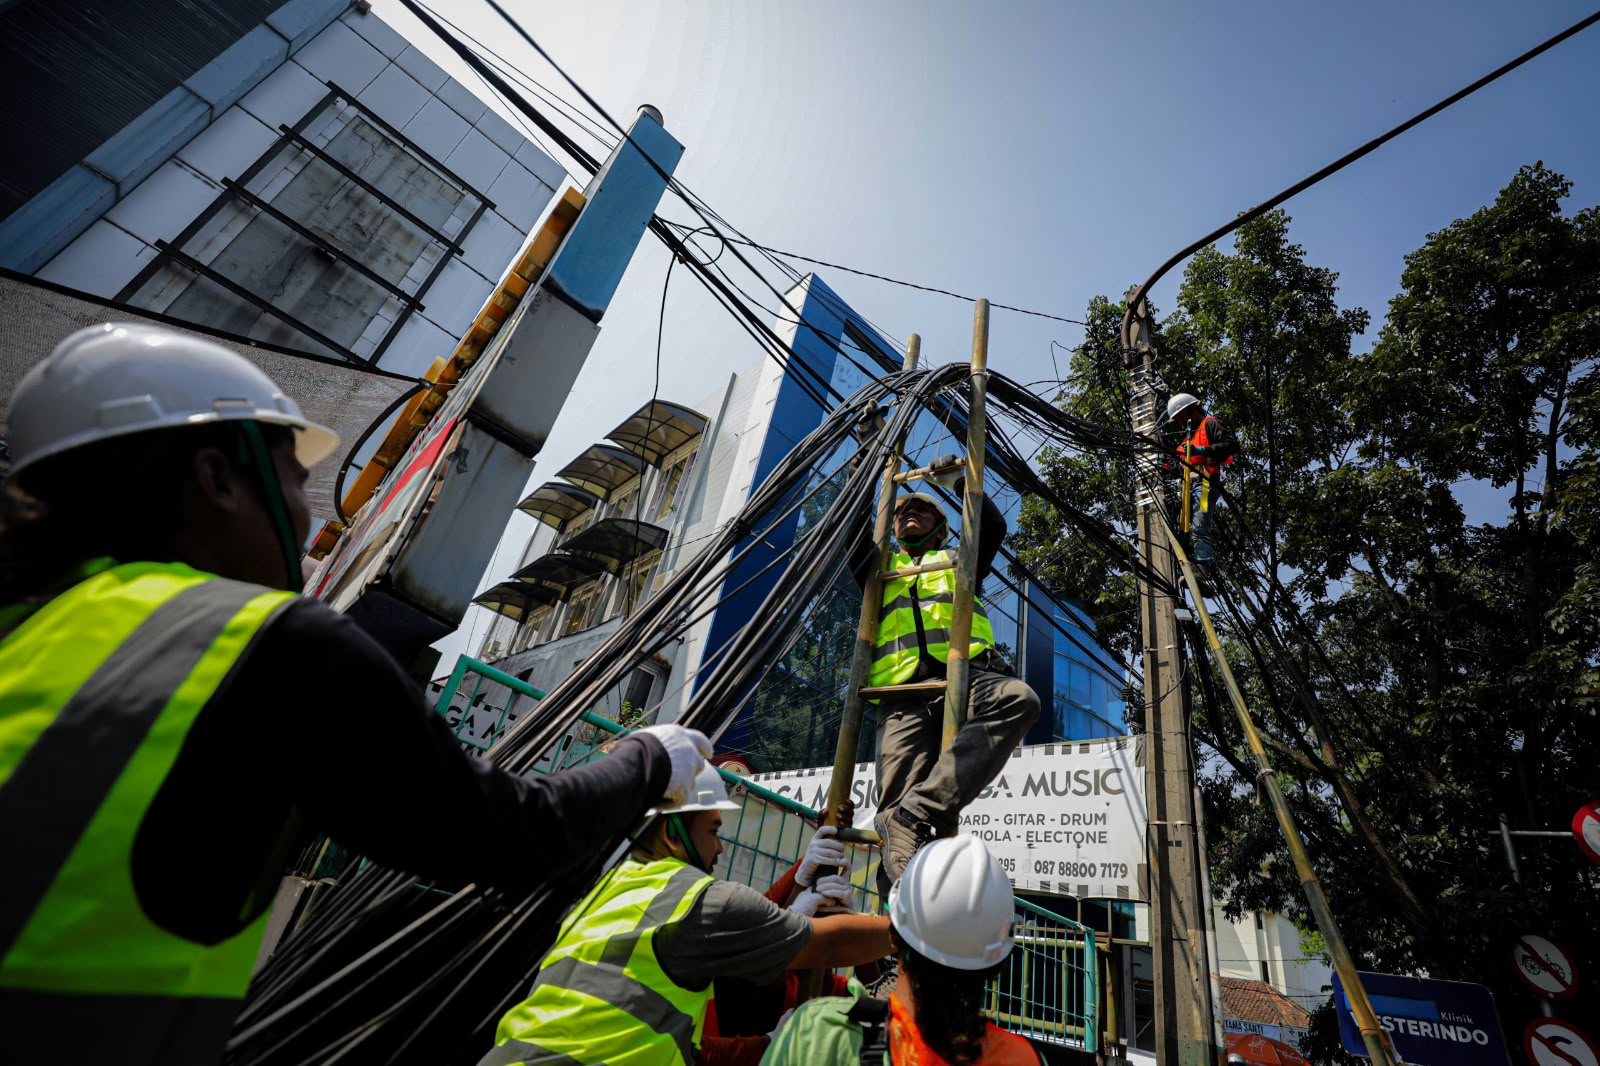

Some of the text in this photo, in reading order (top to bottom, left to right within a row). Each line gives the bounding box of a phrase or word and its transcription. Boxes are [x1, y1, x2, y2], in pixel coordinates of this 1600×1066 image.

[1021, 767, 1125, 798] MUSIC
[811, 779, 879, 809] MSI
[1003, 813, 1046, 826] GITAR
[1060, 813, 1107, 826] DRUM
[1026, 830, 1108, 844] ELECTONE
[1034, 860, 1056, 875] 087
[1058, 861, 1097, 878] 88800
[1100, 862, 1128, 879] 7179
[1440, 1011, 1474, 1025] Klinik
